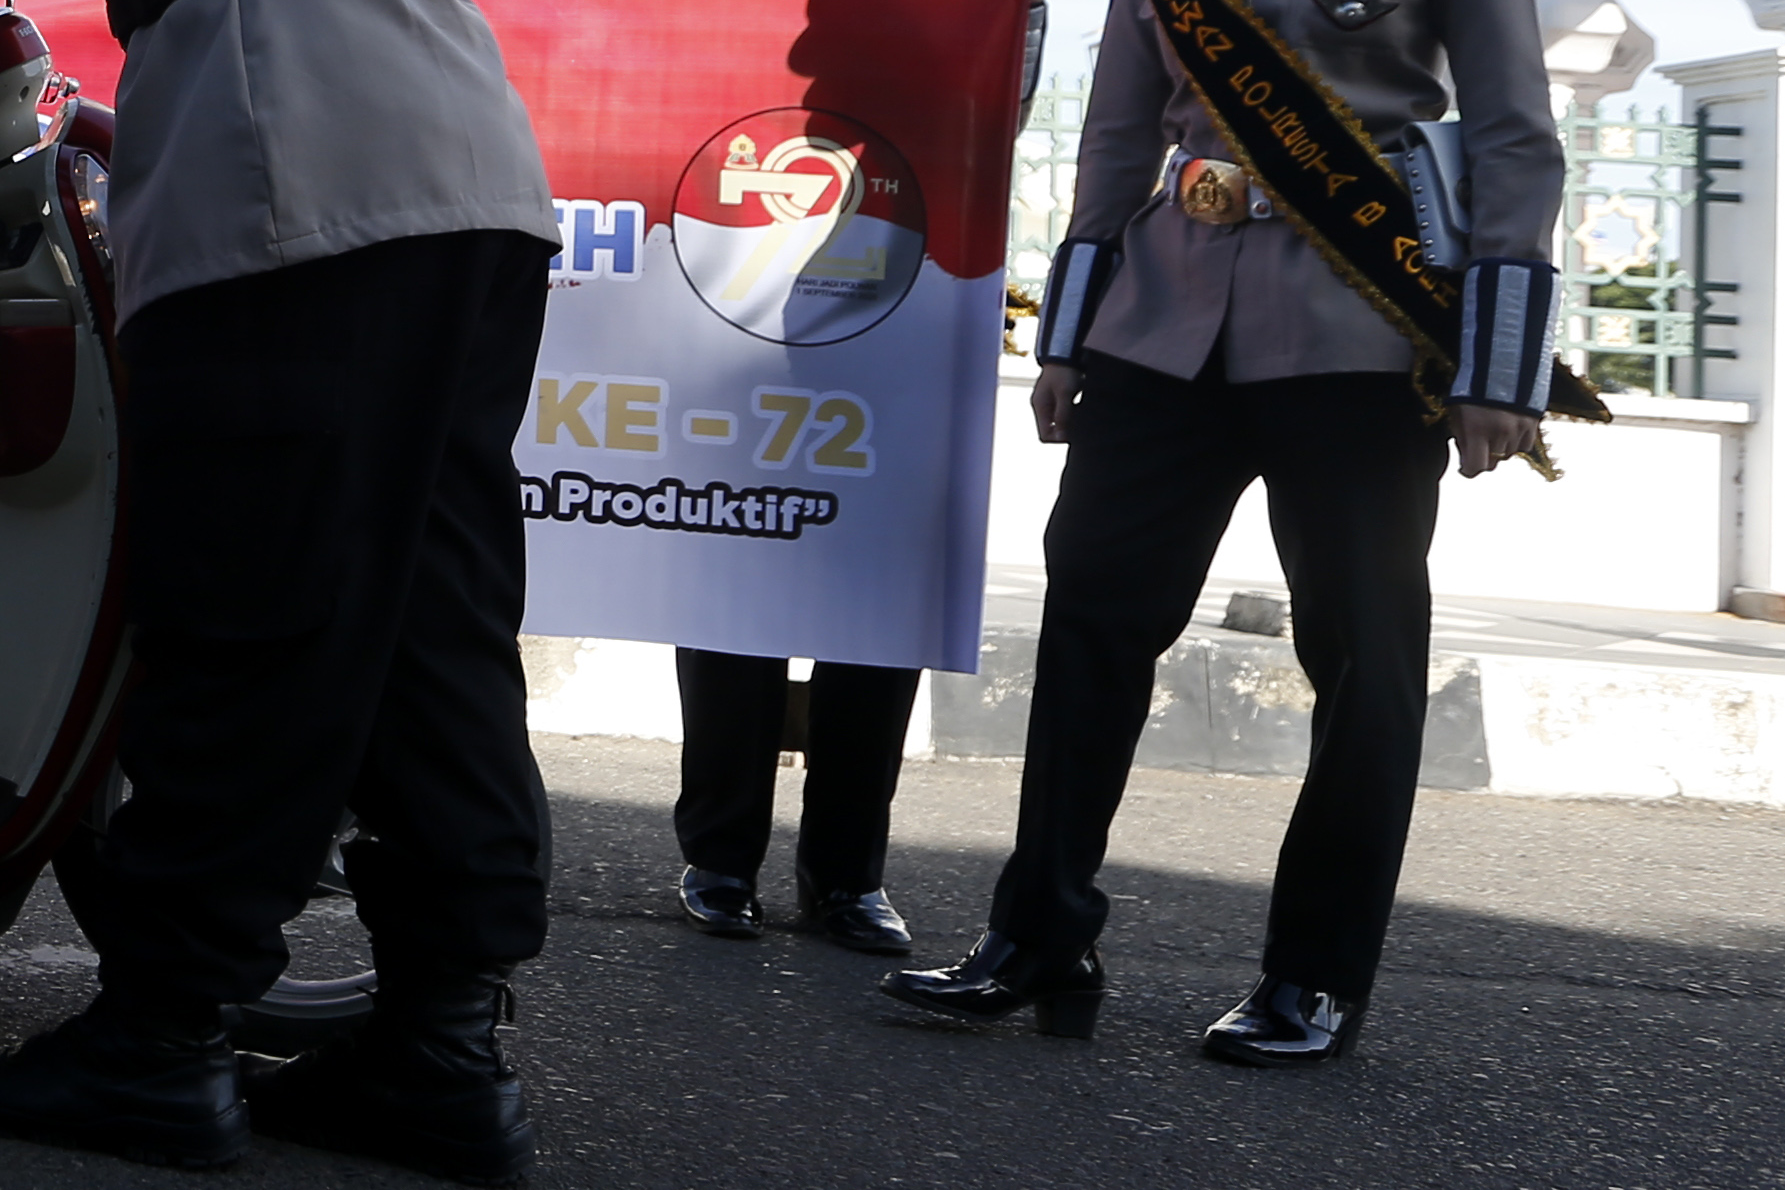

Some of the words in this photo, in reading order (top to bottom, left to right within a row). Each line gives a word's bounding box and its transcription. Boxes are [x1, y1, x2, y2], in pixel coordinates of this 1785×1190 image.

[1228, 65, 1359, 197] POLRESTA
[870, 178, 899, 193] TH
[535, 378, 661, 452] KE
[690, 417, 730, 437] -
[759, 393, 868, 468] 72
[559, 478, 830, 532] Produktif”
